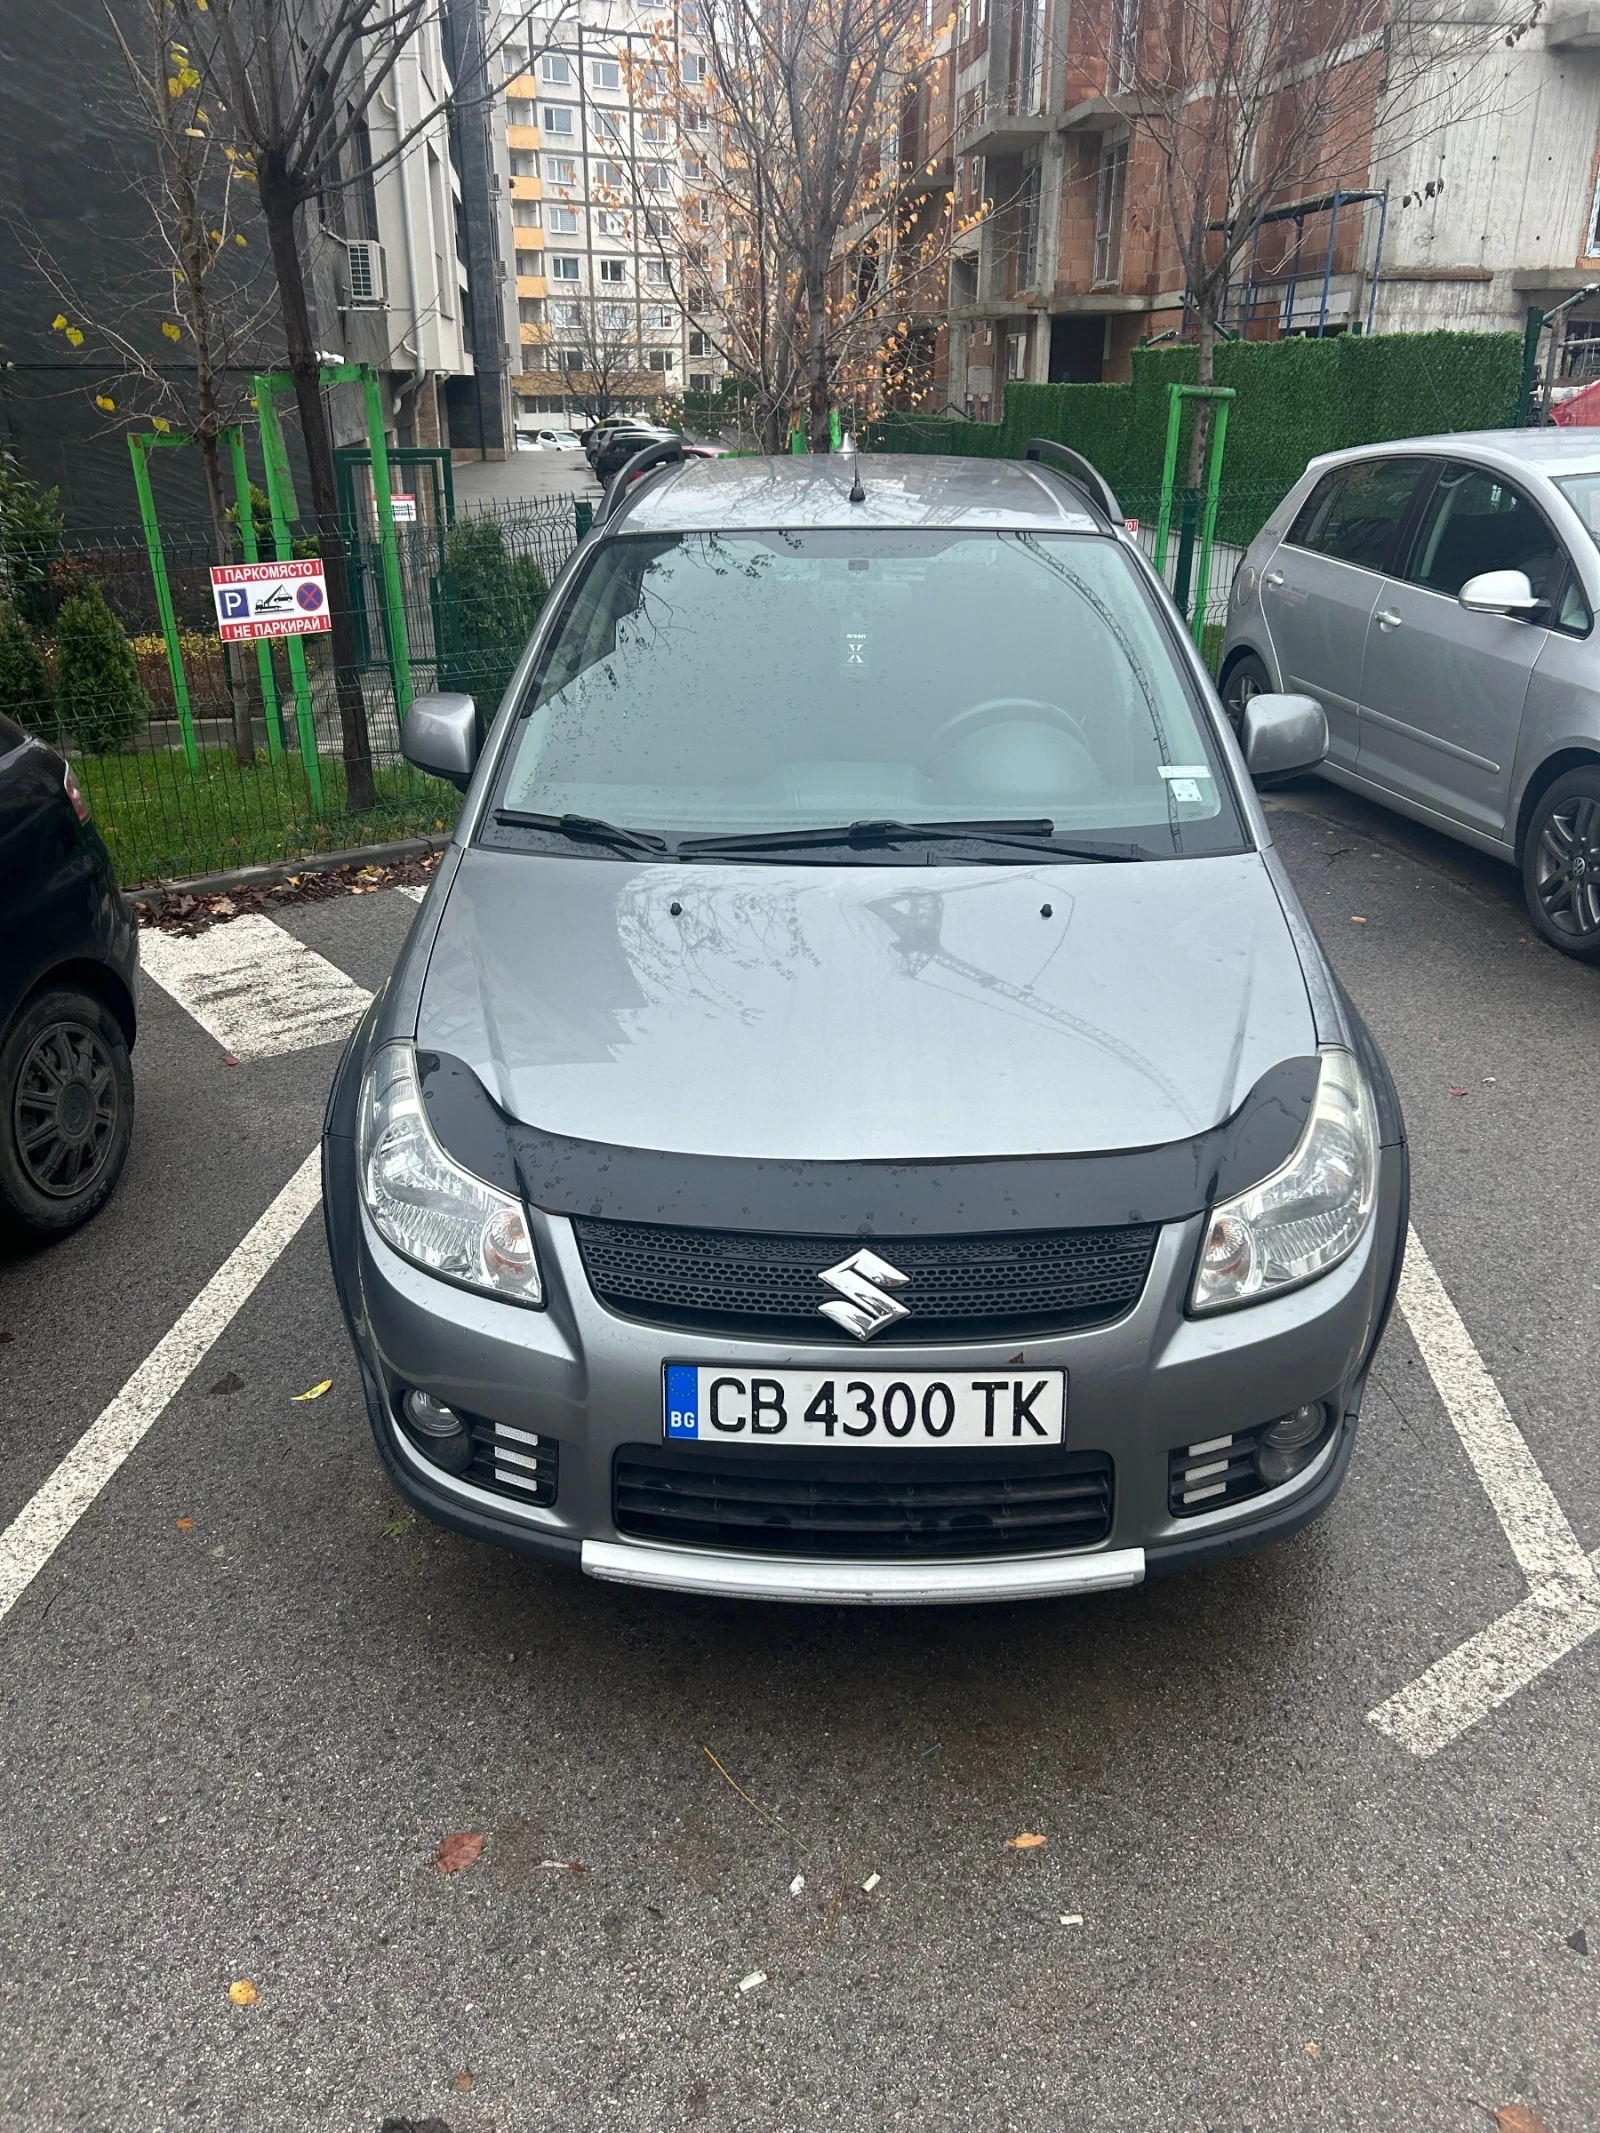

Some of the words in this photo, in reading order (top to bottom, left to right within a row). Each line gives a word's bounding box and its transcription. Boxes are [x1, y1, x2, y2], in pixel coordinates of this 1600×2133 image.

[225, 563, 313, 582] ПАРКОМЯСТО
[233, 624, 252, 638] НЕ
[254, 616, 321, 636] ПАРКИРАЙ
[709, 1376, 788, 1434] CB
[803, 1380, 956, 1437] 4300
[971, 1380, 1049, 1437] TK
[670, 1410, 696, 1429] BG
